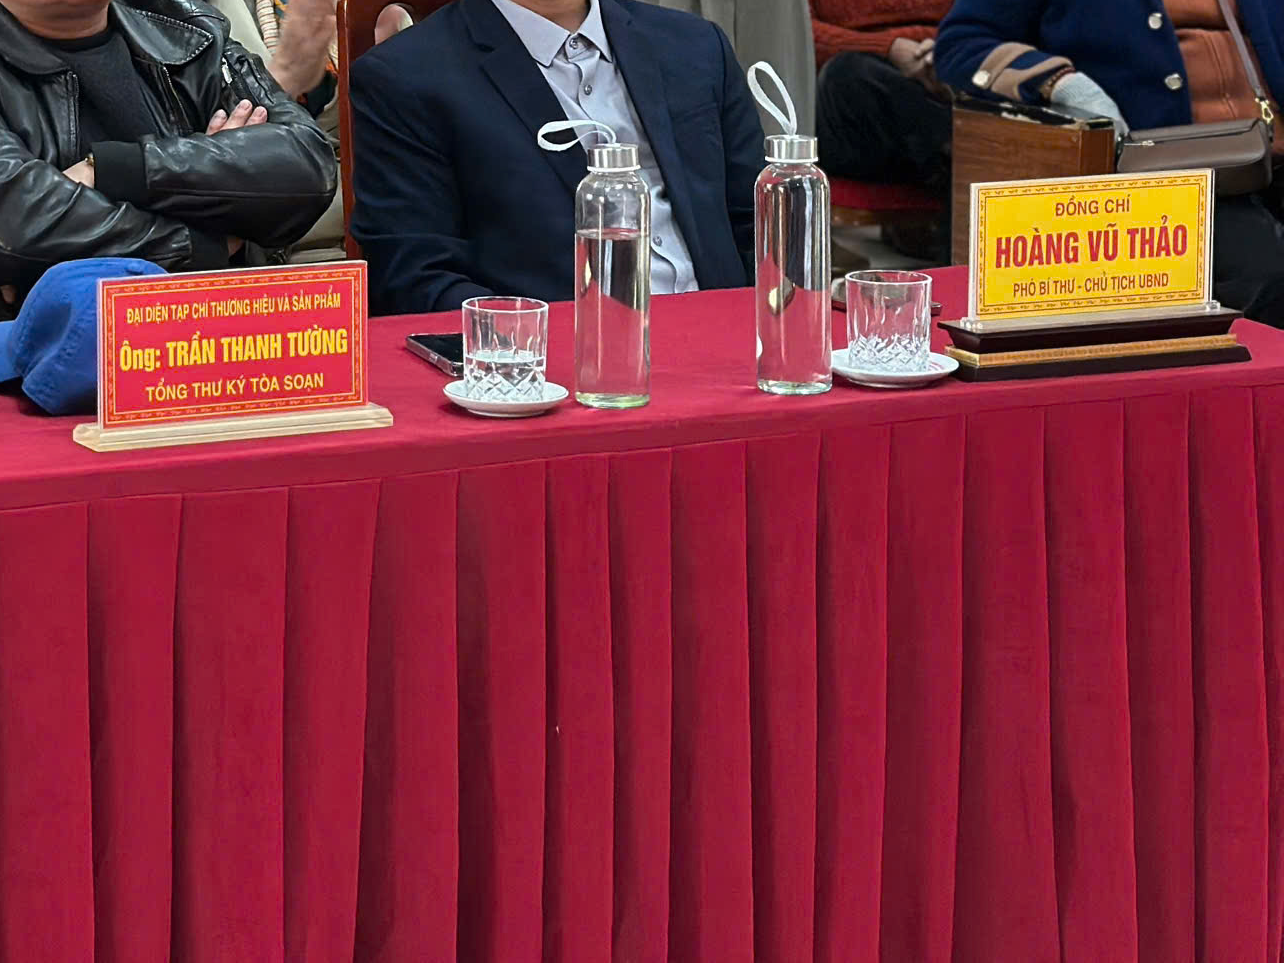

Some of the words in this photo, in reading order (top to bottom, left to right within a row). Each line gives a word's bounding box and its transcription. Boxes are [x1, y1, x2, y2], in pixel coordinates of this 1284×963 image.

[1055, 195, 1099, 217] ĐỒNG
[1104, 194, 1131, 213] CHÍ
[996, 227, 1079, 268] HOÀNG
[1088, 223, 1118, 261] VŨ
[1126, 214, 1188, 260] THẢO
[1013, 277, 1037, 298] PHÓ
[1039, 277, 1051, 295] BÍ
[1052, 277, 1076, 294] THƯ
[1084, 271, 1108, 292] CHỦ
[1110, 276, 1136, 293] TỊCH
[1138, 272, 1169, 289] UBND
[126, 307, 144, 326] ĐẠI
[145, 302, 169, 324] DIỆN
[170, 303, 190, 323] TẠP
[192, 298, 209, 319] CHÍ
[210, 297, 251, 318] THƯƠNG
[252, 293, 276, 317] HIỆU
[277, 292, 291, 312] VÀ
[292, 289, 313, 311] SẢN
[314, 284, 341, 309] PHẨM
[119, 339, 161, 372] Ông:
[165, 330, 216, 367] TRẦN
[220, 333, 282, 363] THANH
[287, 324, 349, 358] TƯỜNG
[145, 377, 188, 402] TỔNG
[192, 377, 223, 398] THƯ
[226, 374, 246, 395] KÝ
[250, 373, 280, 393] TÒA
[283, 372, 324, 392] SOẠN
